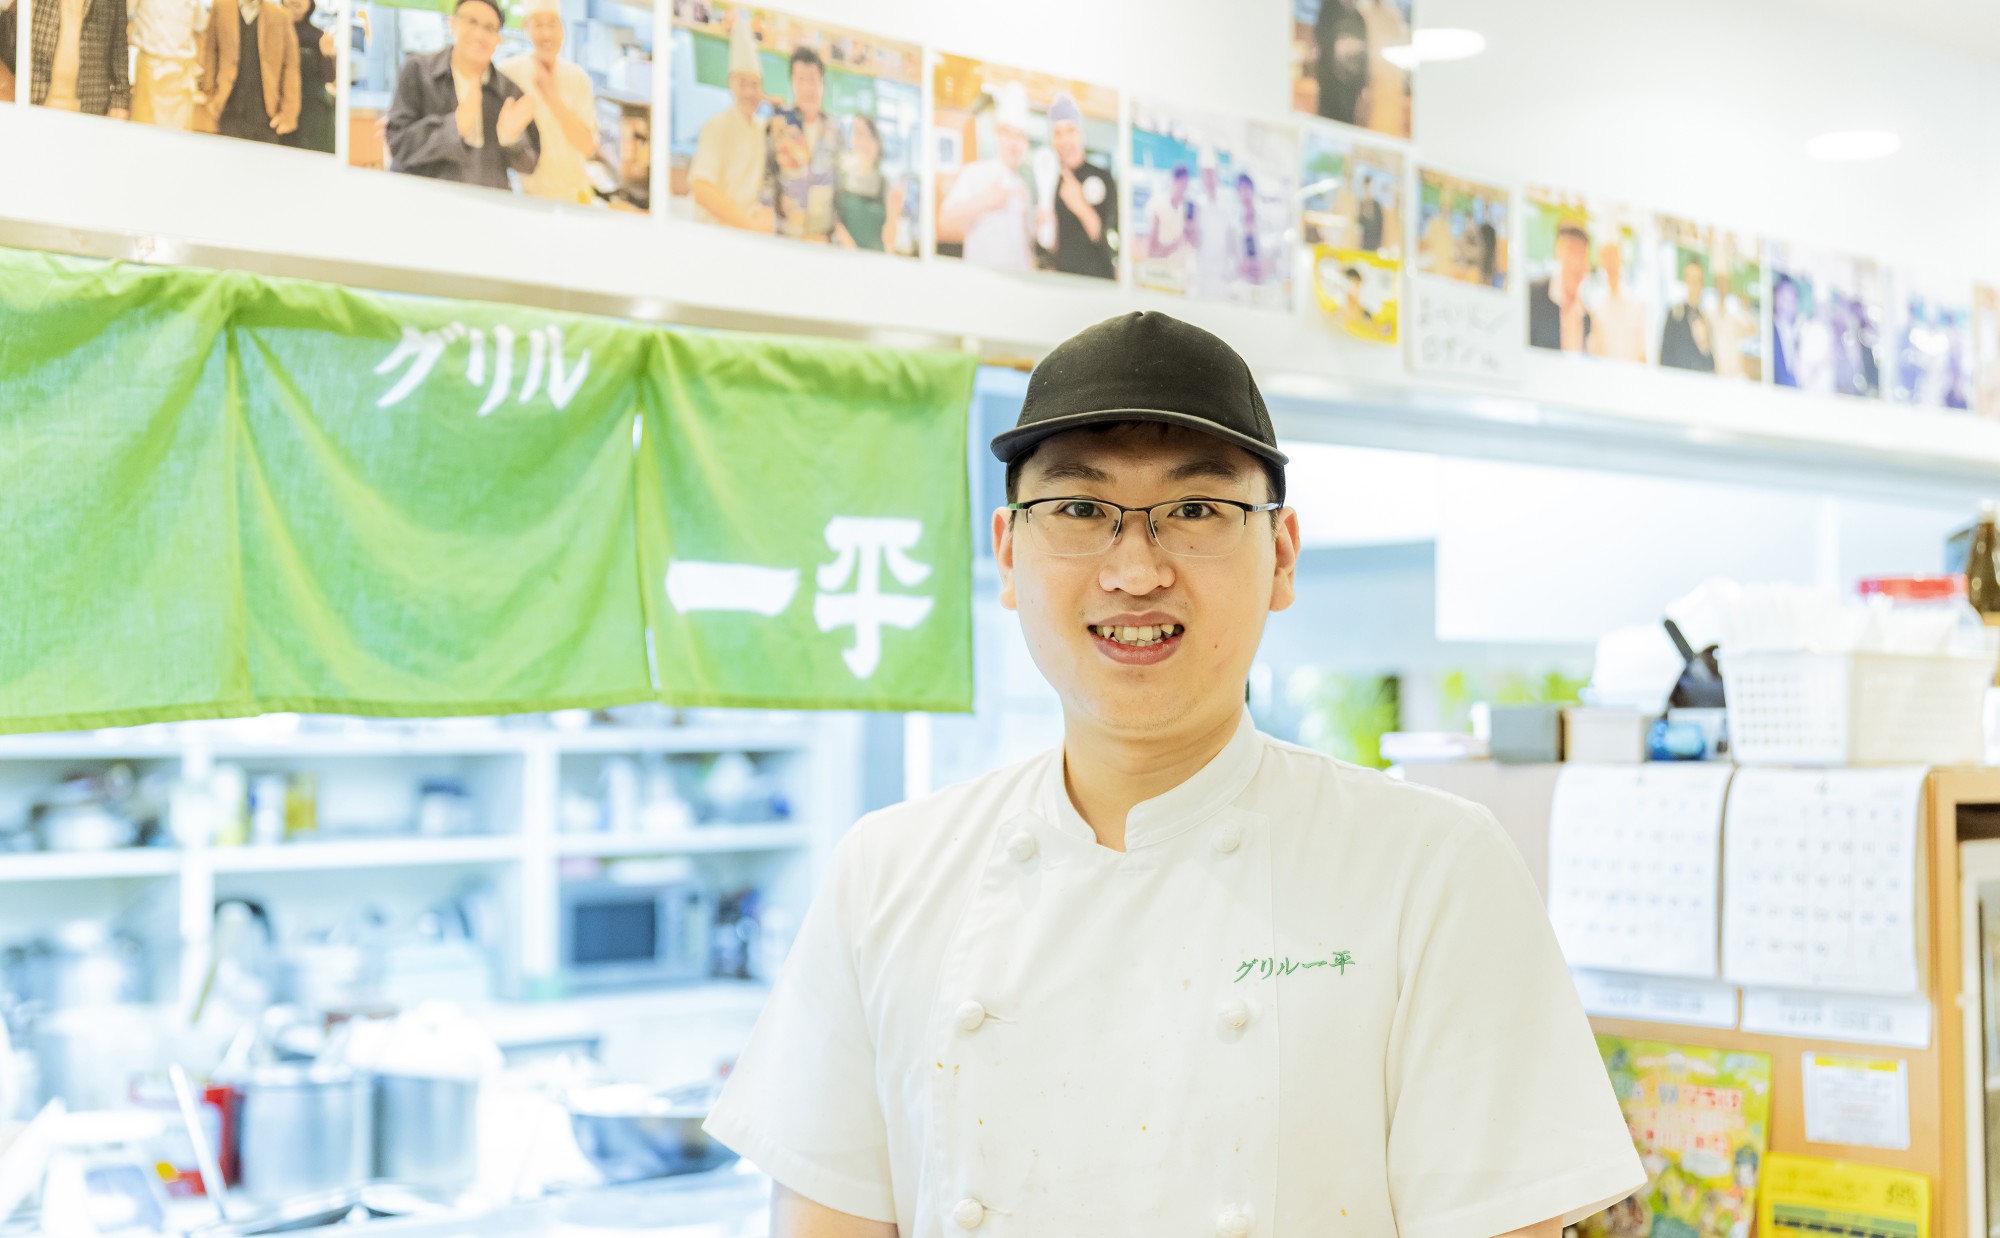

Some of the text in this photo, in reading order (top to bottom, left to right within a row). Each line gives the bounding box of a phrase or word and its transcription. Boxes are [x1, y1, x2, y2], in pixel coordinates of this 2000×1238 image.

[373, 321, 590, 417] グリル
[665, 515, 935, 680] 一平
[1233, 950, 1356, 983] グリル一平
